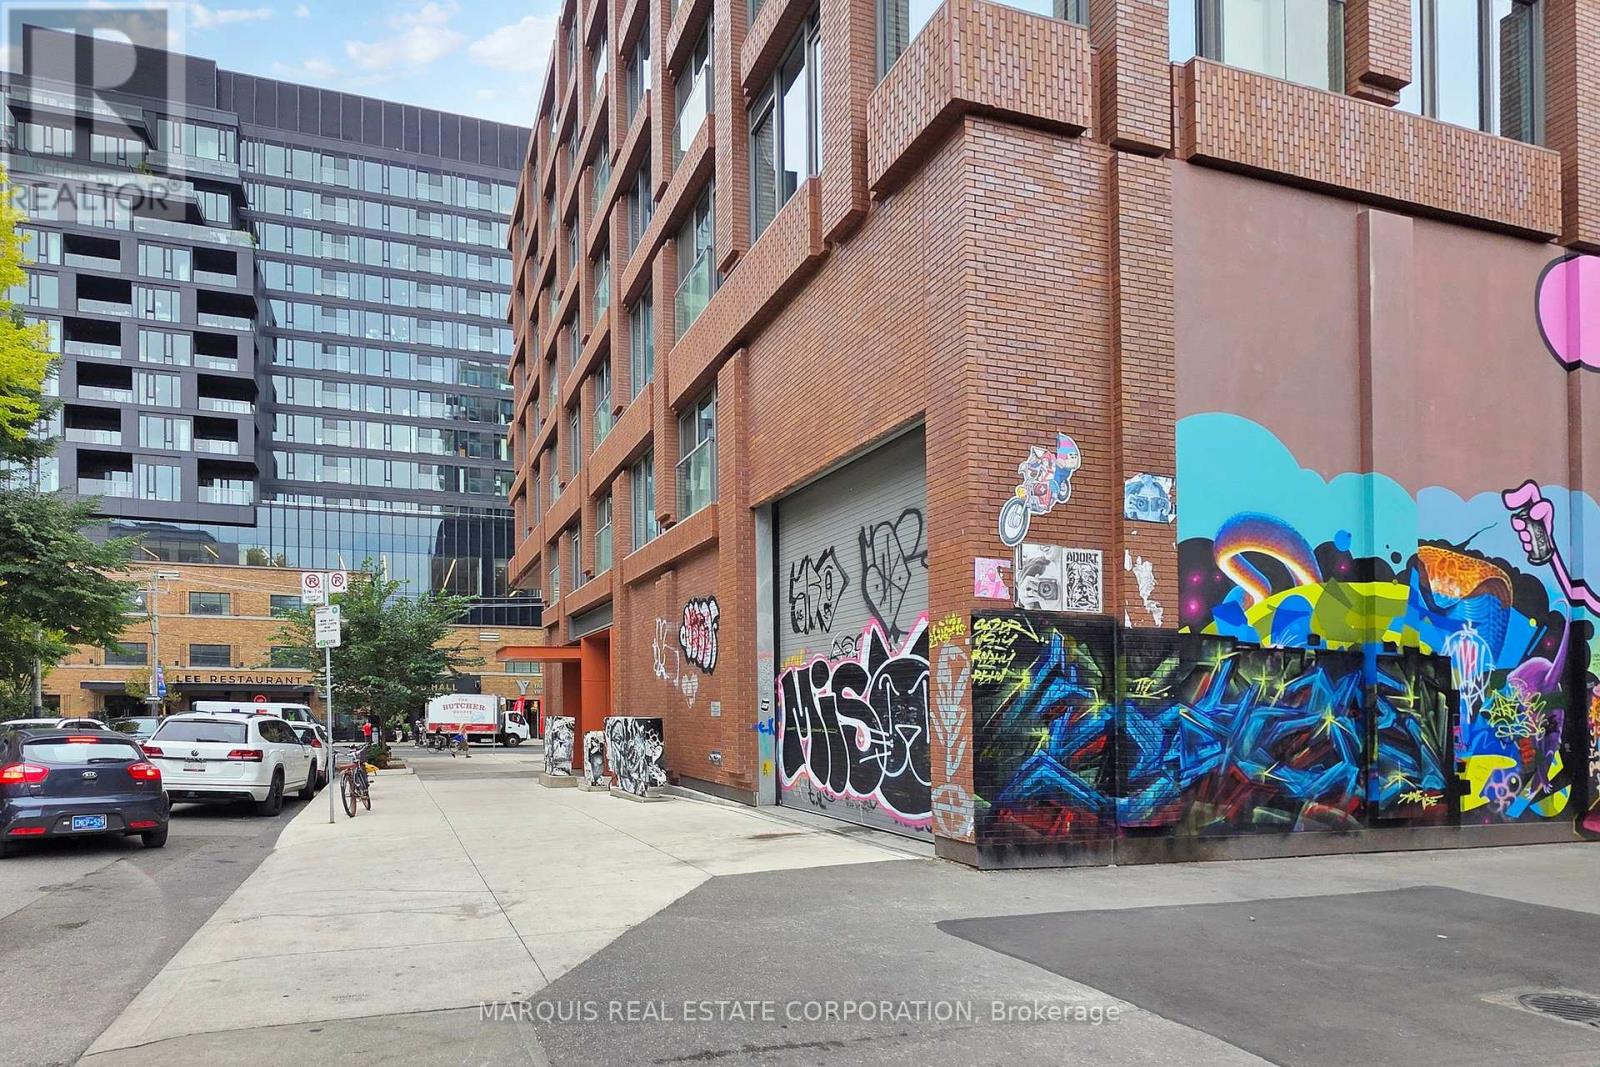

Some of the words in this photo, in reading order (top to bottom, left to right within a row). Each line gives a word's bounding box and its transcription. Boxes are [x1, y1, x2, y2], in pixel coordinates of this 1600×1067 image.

[176, 675, 200, 683] LEE
[209, 675, 302, 684] RESTAURANT
[442, 702, 486, 710] BUTCHER
